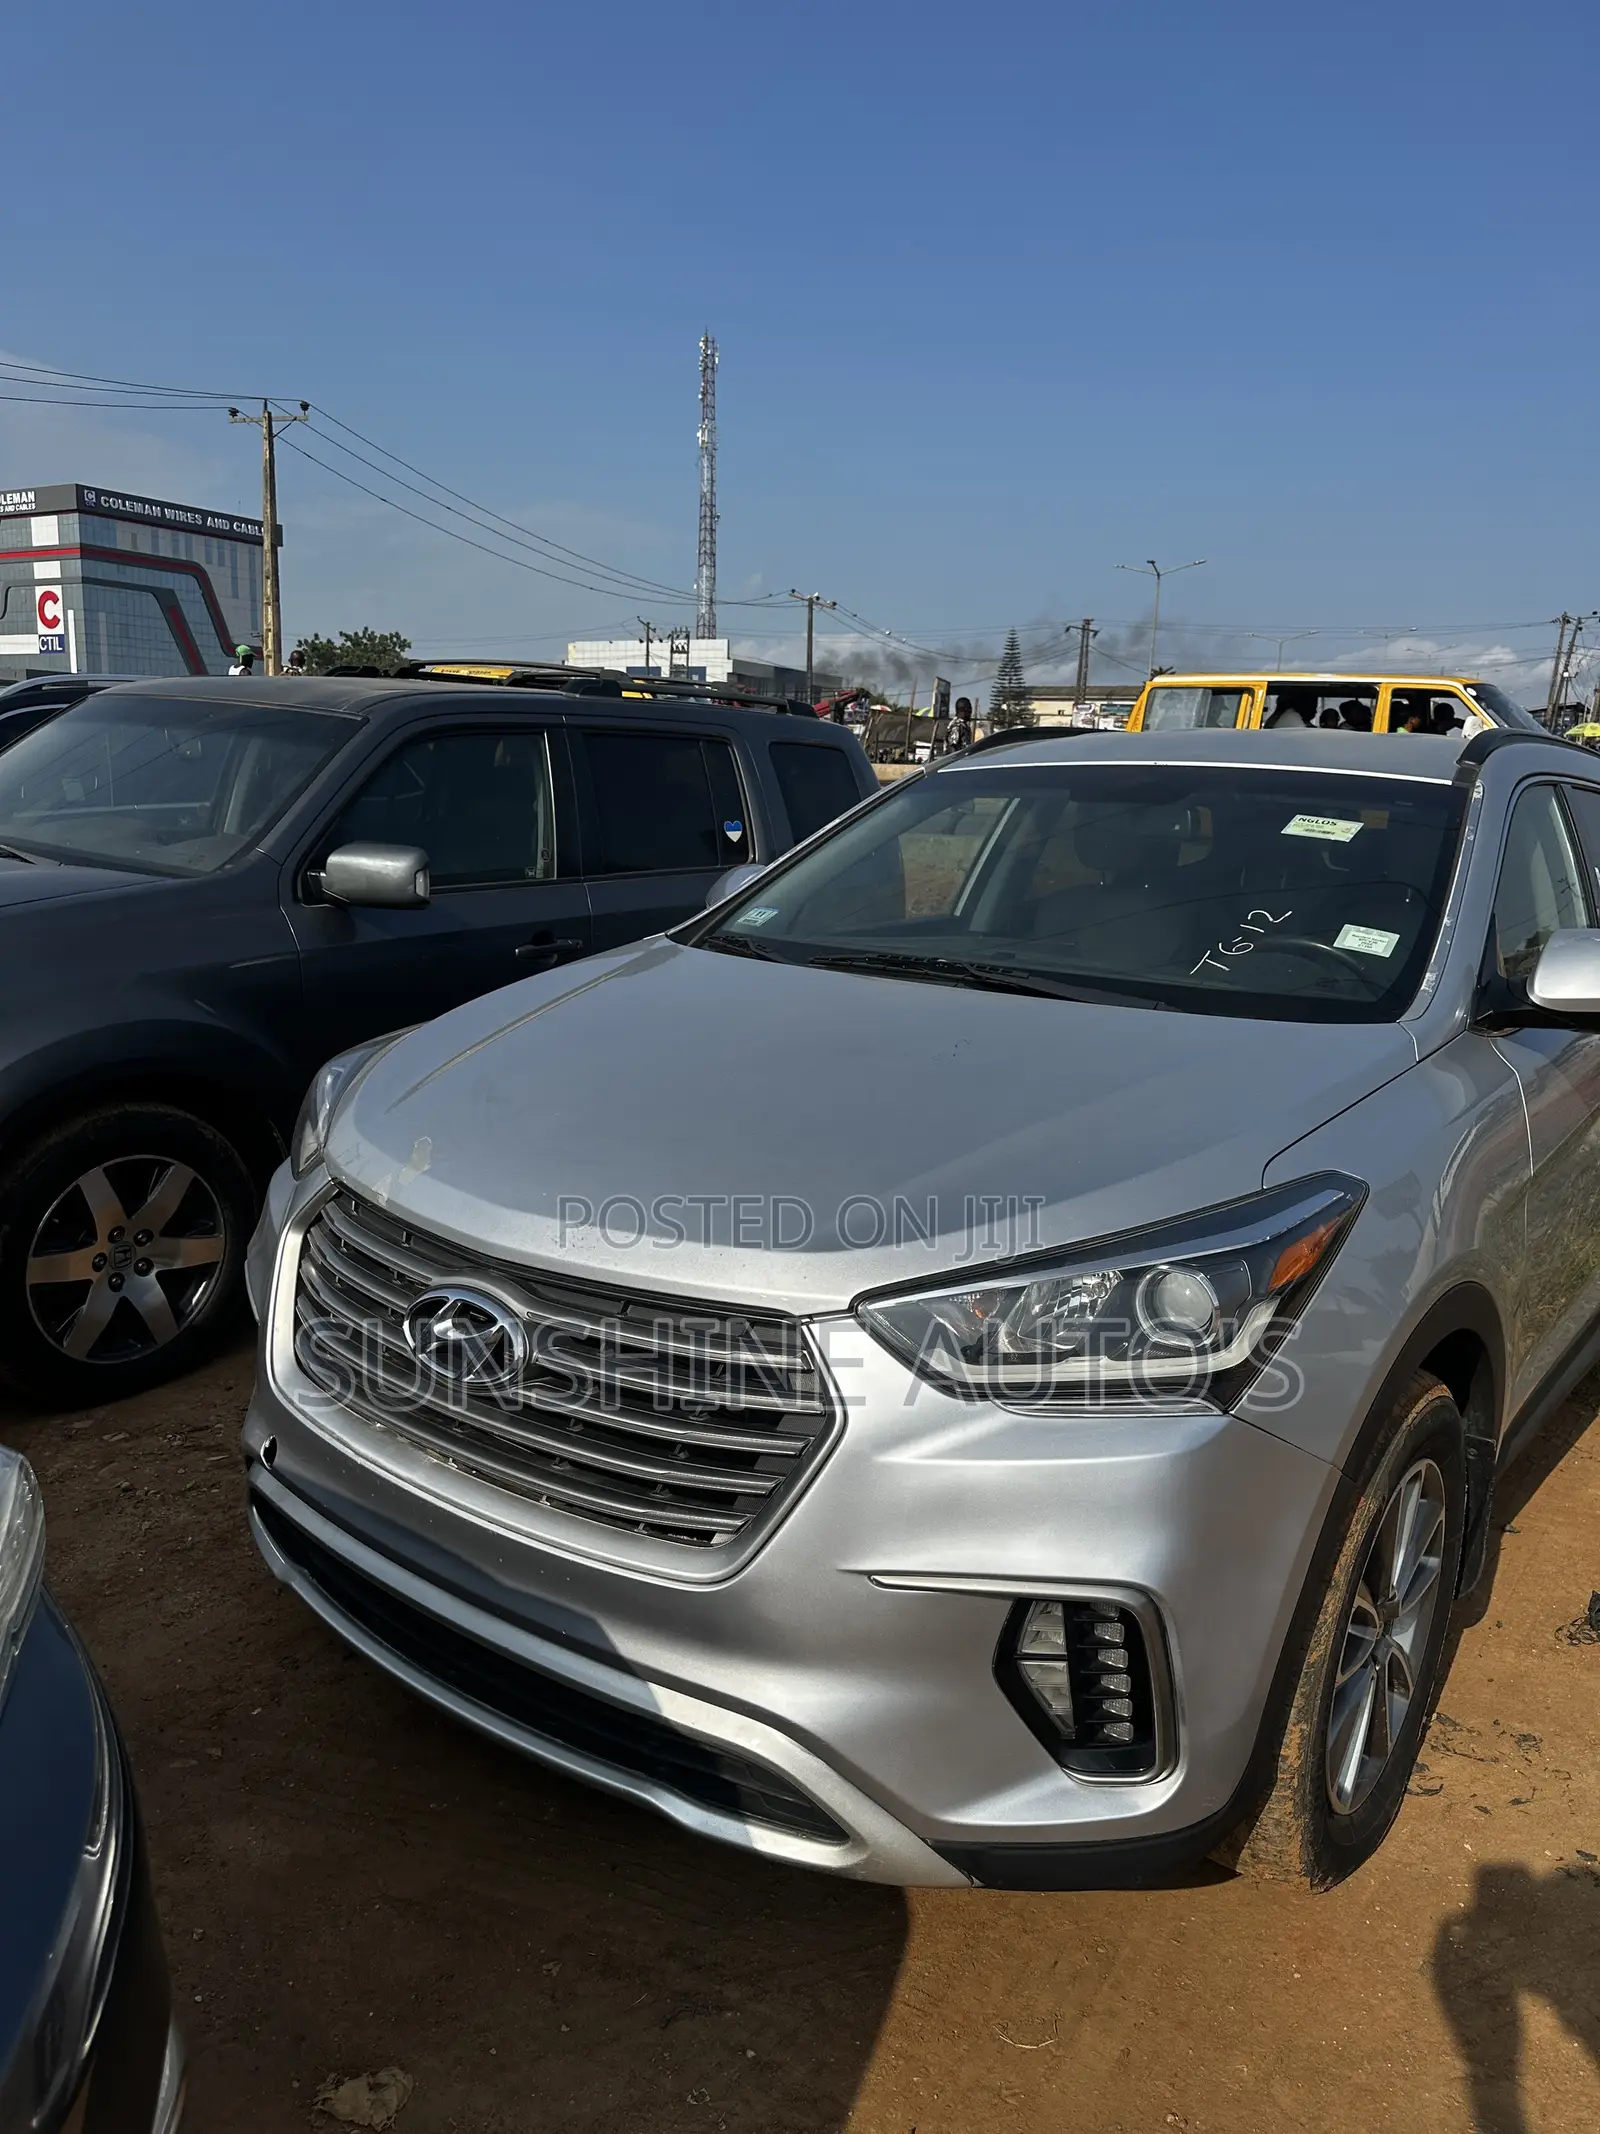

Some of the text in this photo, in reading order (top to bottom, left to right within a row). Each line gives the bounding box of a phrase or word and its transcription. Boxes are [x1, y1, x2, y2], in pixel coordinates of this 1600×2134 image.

[16, 502, 36, 511] CABLES
[100, 496, 264, 537] COLEMAN WIRES AND CABL
[37, 590, 61, 629] C
[39, 636, 63, 651] CTIL
